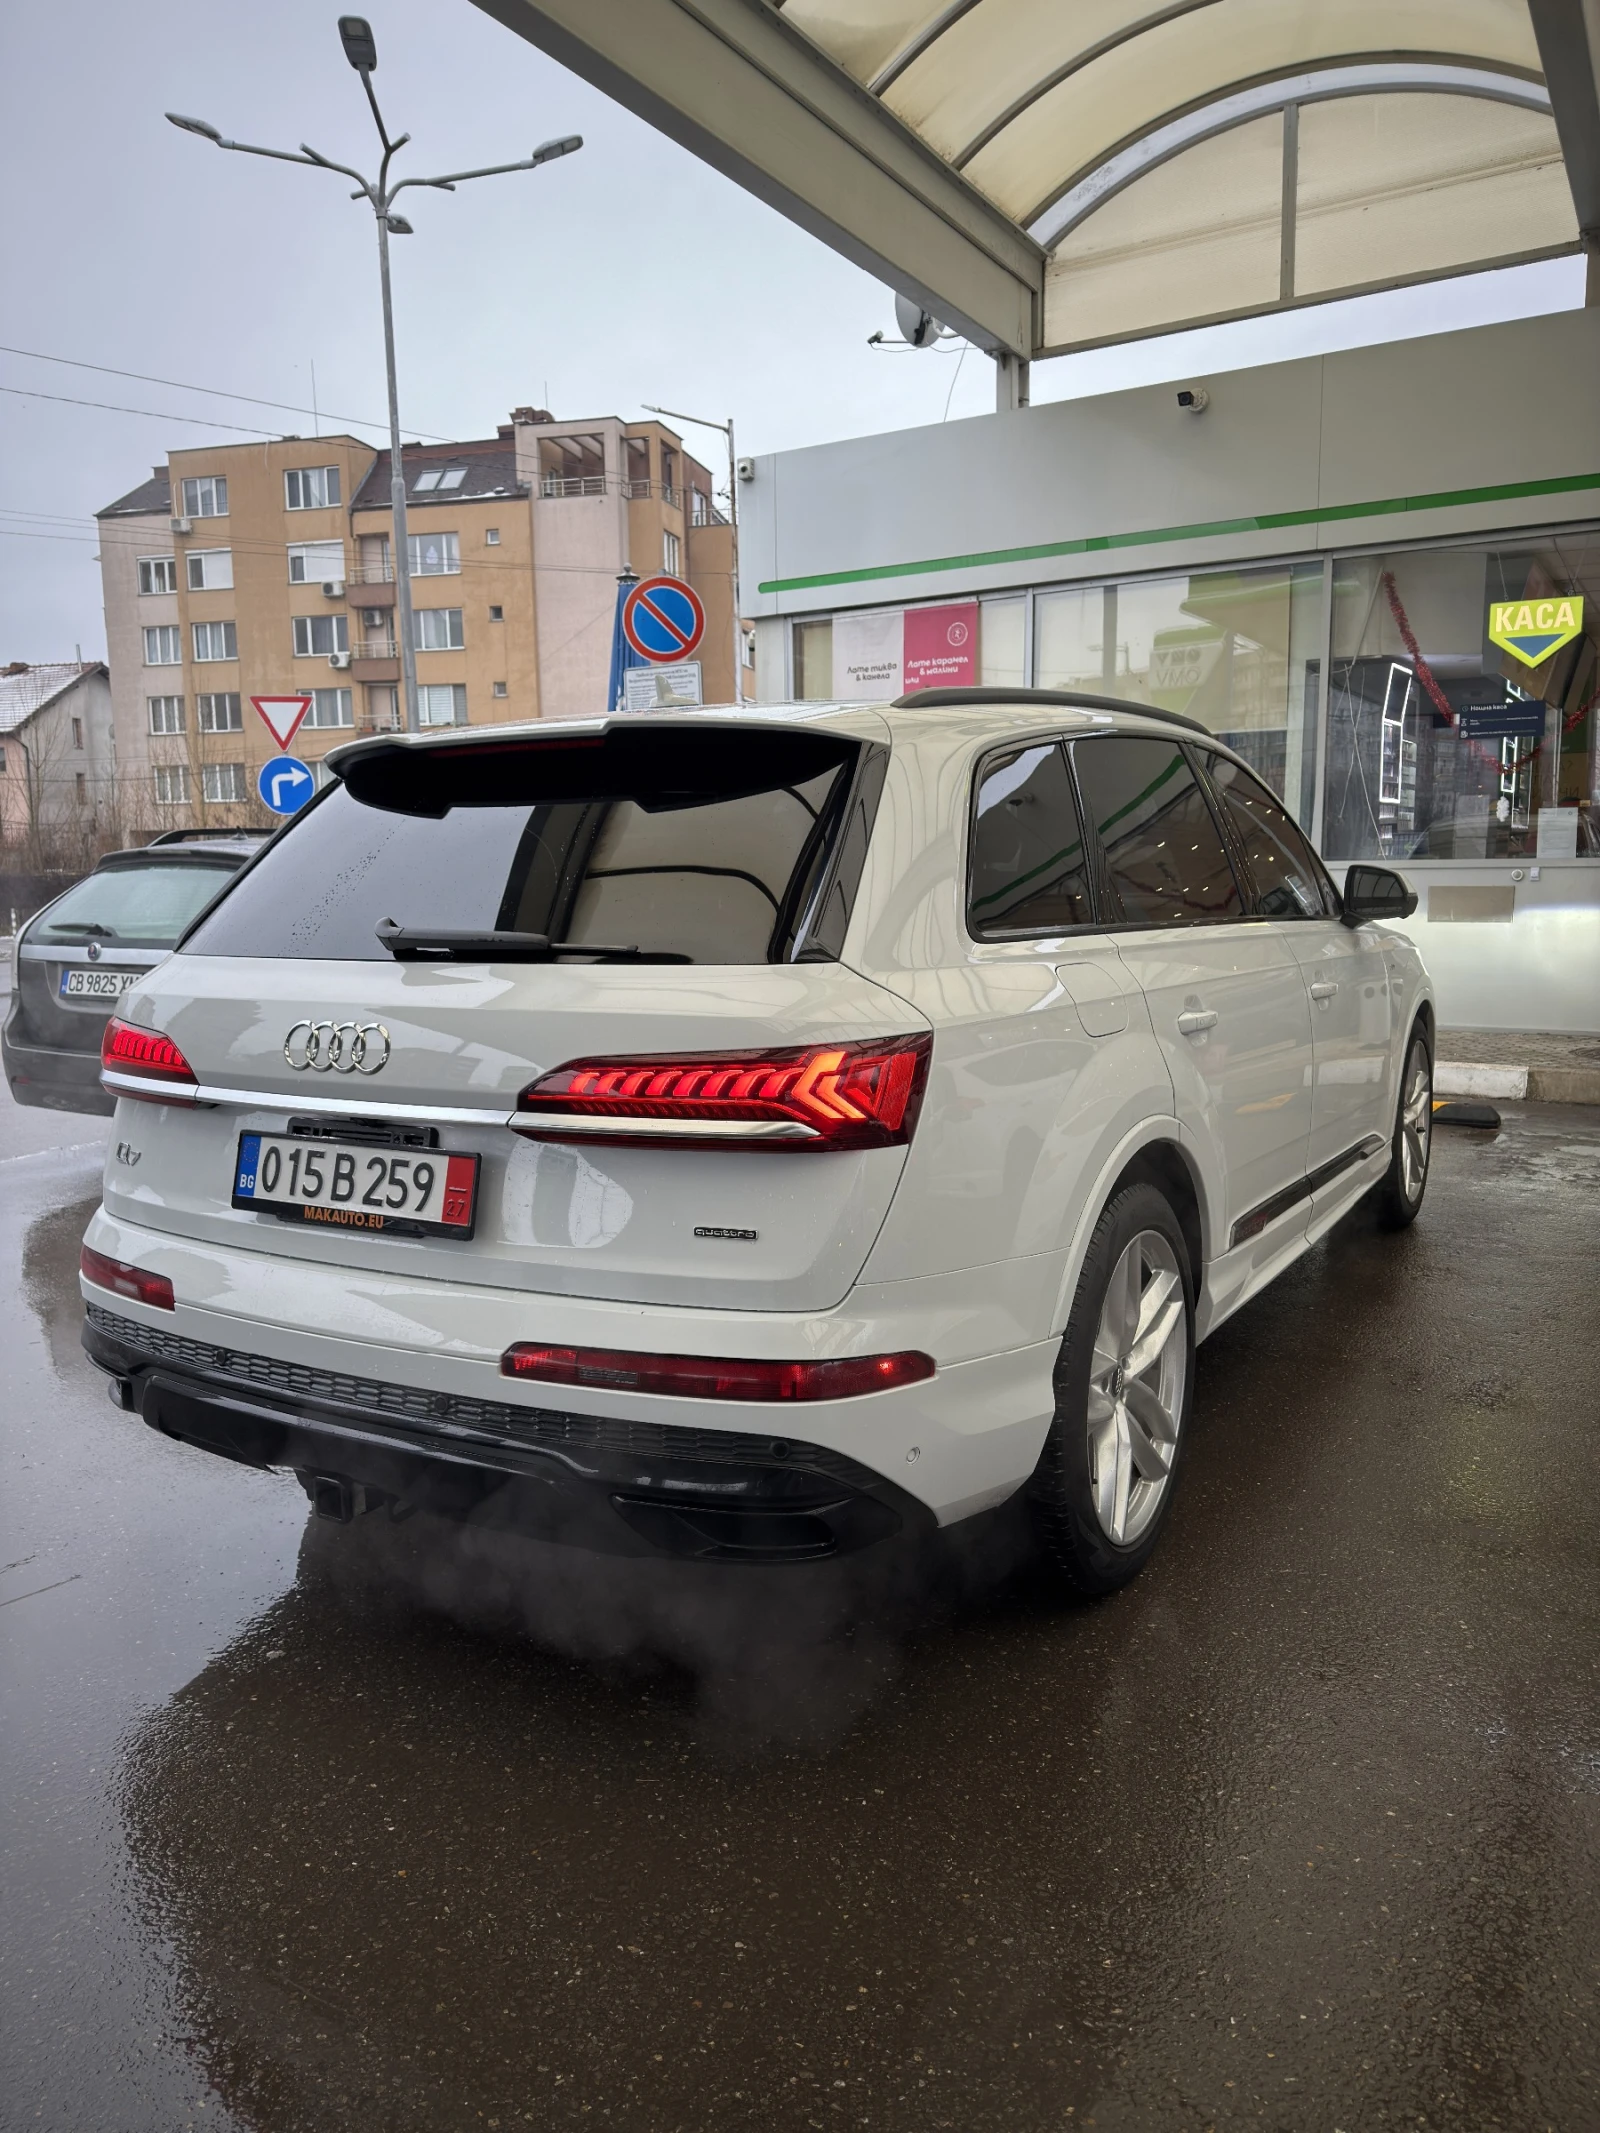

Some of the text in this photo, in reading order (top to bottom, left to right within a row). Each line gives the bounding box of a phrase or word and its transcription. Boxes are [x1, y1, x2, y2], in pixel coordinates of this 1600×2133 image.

[1495, 602, 1575, 632] КАСА
[847, 662, 897, 674] Лате тиква
[907, 656, 969, 668] Лате карамел
[862, 673, 890, 681] канела
[919, 665, 959, 676] & малини
[68, 973, 84, 992] CB
[86, 974, 118, 993] 9825
[116, 1141, 142, 1167] Q7
[239, 1174, 254, 1189] BG
[304, 1206, 384, 1229] MAKAUTO.EU
[695, 1228, 755, 1238] quattro
